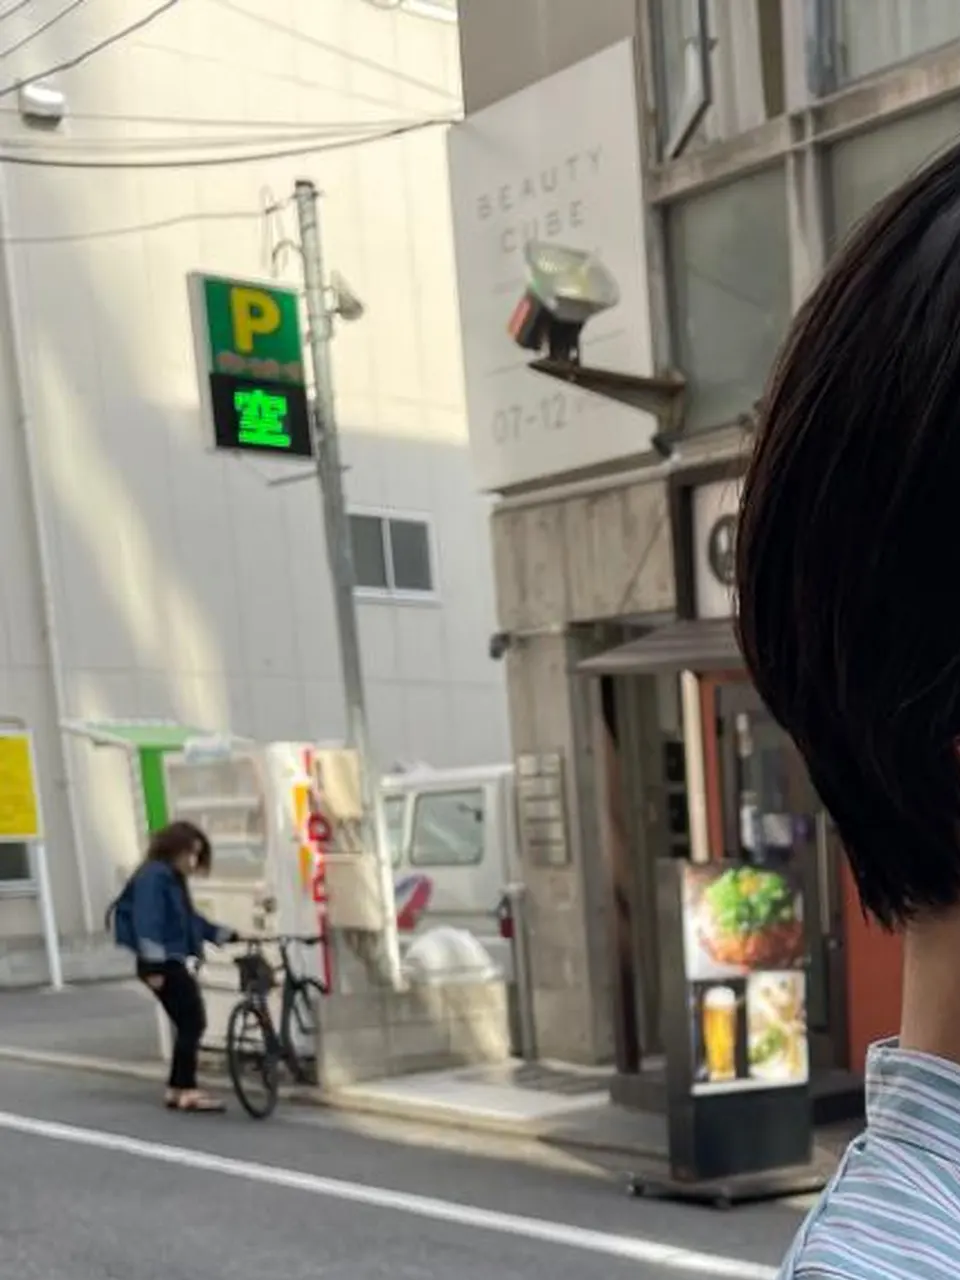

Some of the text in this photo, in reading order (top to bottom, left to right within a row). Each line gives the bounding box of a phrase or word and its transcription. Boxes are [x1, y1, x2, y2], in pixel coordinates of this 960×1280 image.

[476, 143, 603, 221] BEAUTY
[501, 199, 585, 254] CUBE
[230, 285, 281, 354] P
[234, 389, 291, 447] 空
